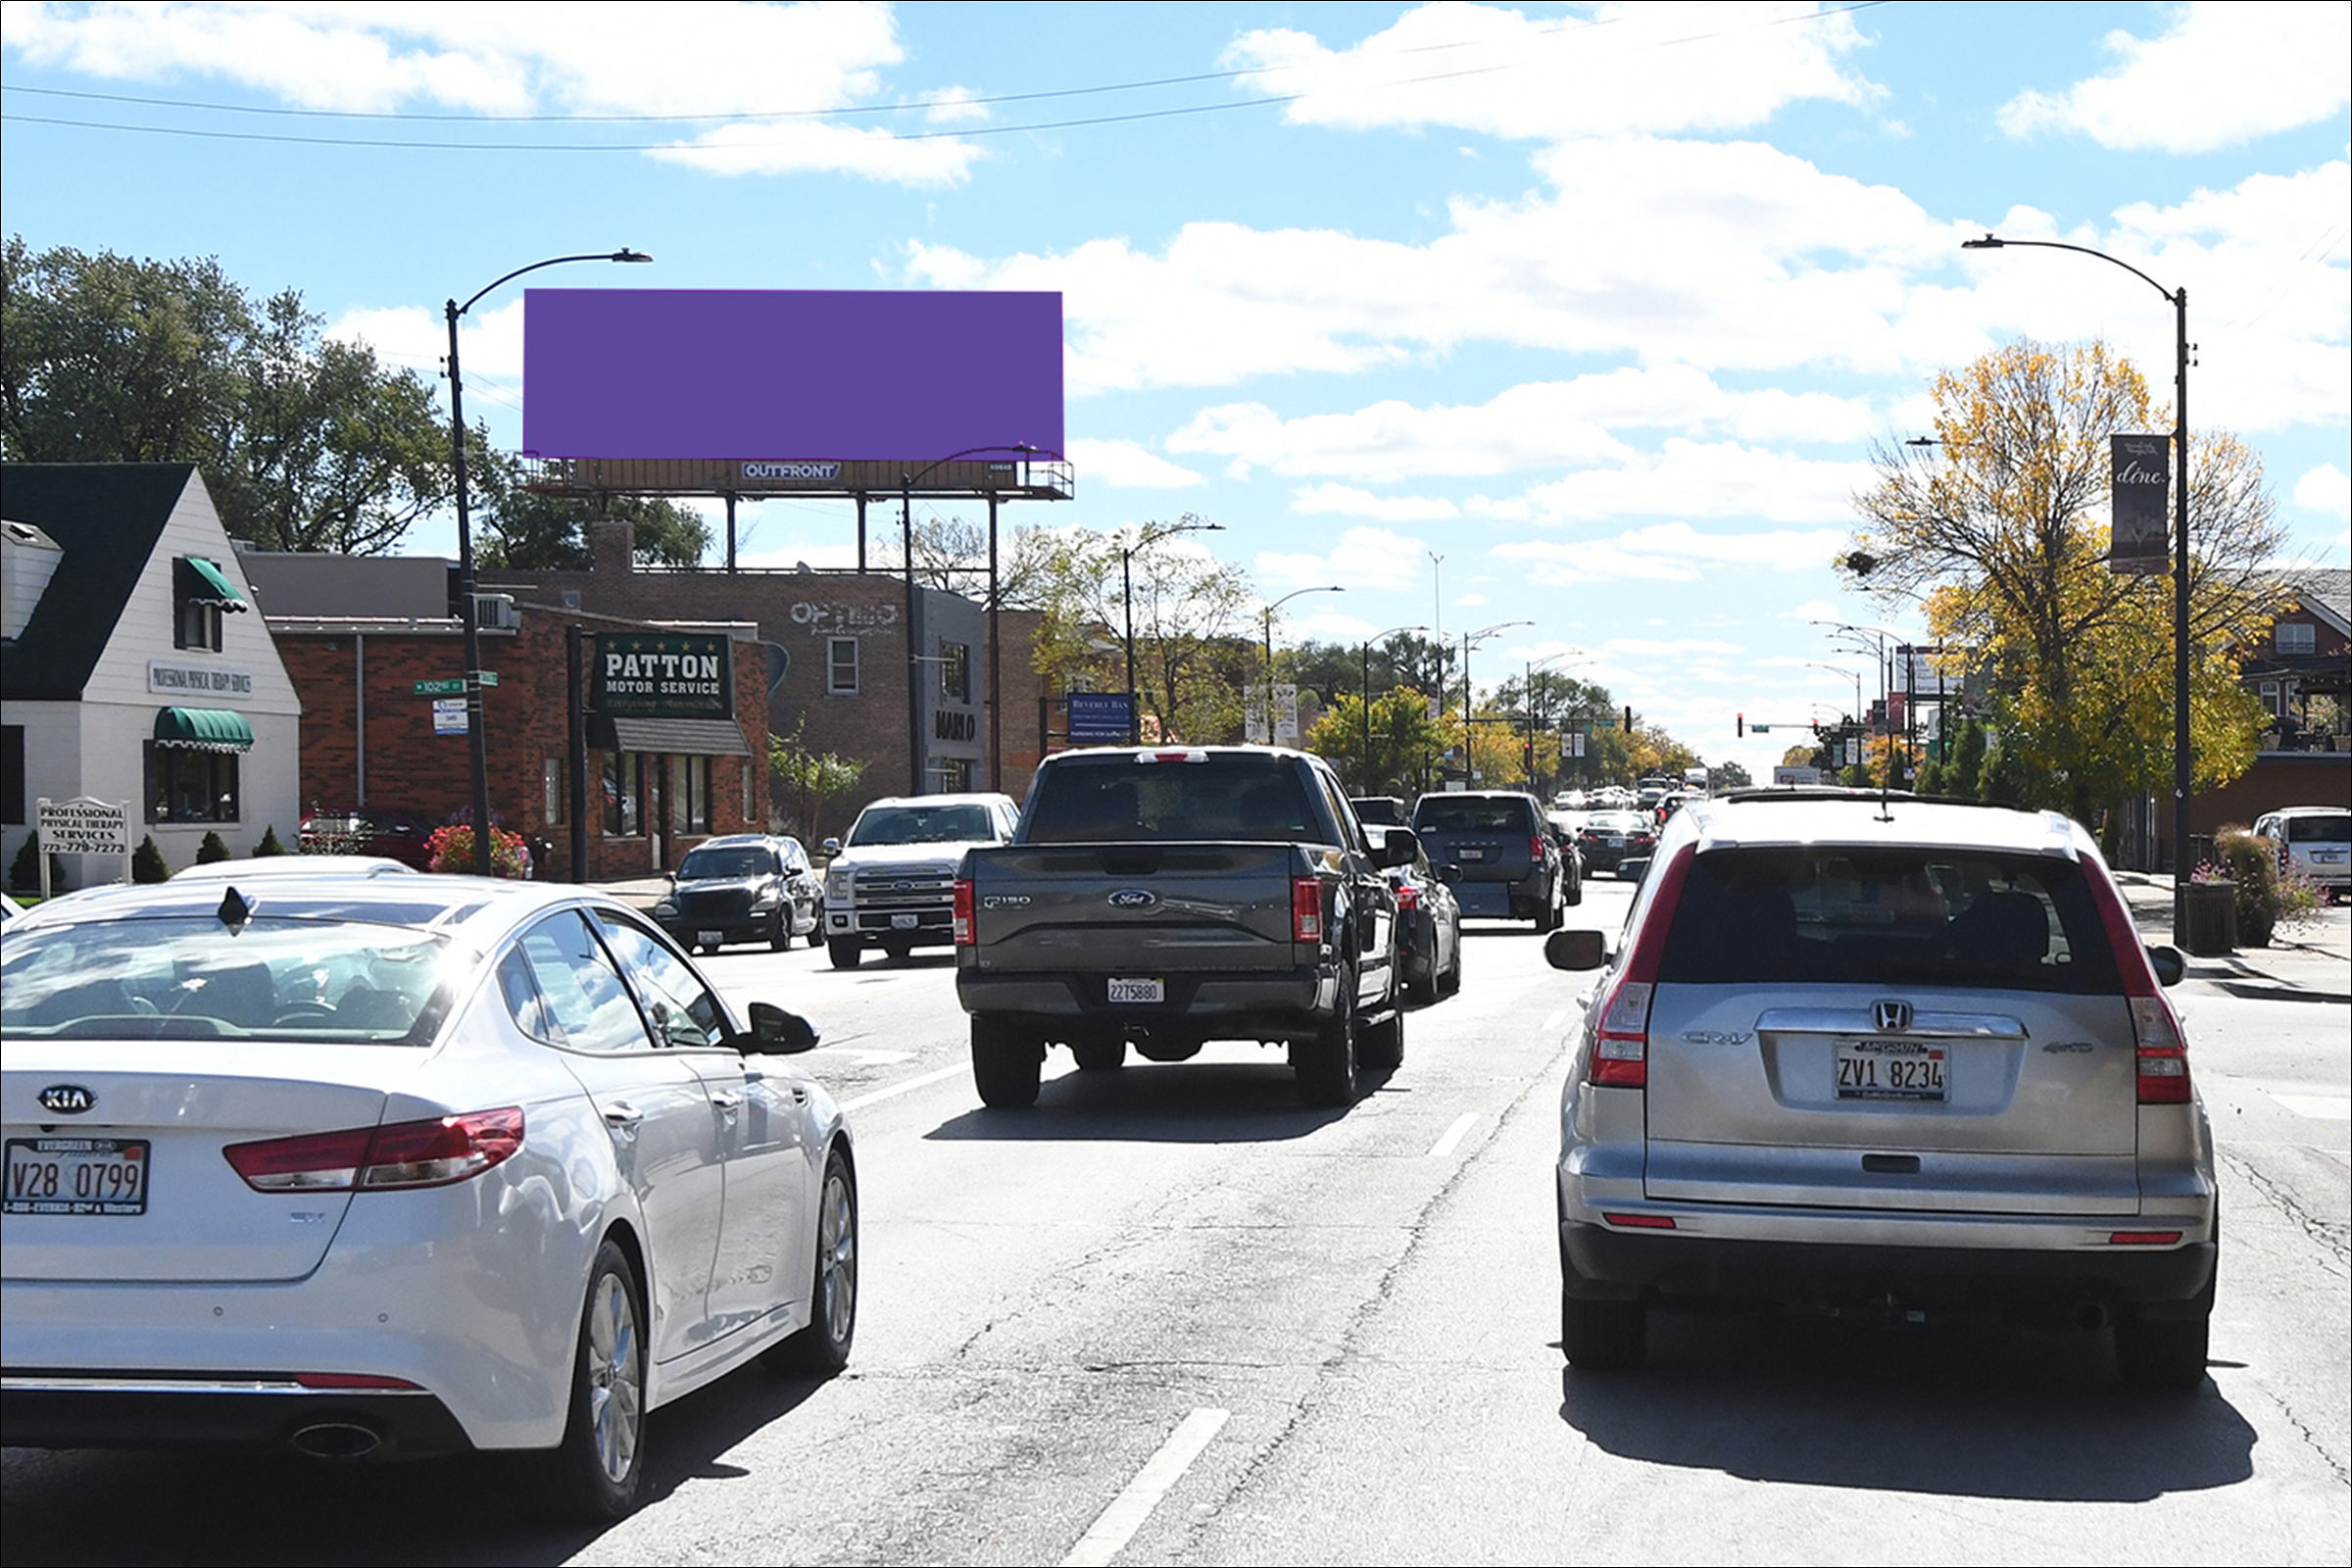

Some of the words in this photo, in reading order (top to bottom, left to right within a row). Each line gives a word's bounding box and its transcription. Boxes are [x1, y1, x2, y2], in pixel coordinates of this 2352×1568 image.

[746, 464, 835, 477] OUTFRONT
[606, 653, 718, 679] PATTON
[606, 680, 654, 693] MOTOR
[661, 681, 720, 695] SERVICE
[40, 808, 122, 819] PROFESSIONAL
[40, 818, 82, 828] PHYSICAL
[85, 819, 124, 830] THERAPY
[52, 829, 116, 840] SERVICES
[42, 843, 125, 854] 773-779-7273
[1117, 893, 1145, 906] Ford
[1839, 1057, 1878, 1087] ZV1
[1890, 1059, 1943, 1089] 8234
[46, 1089, 87, 1108] KIA
[13, 1162, 60, 1199] V28
[75, 1162, 139, 1200] 0799
